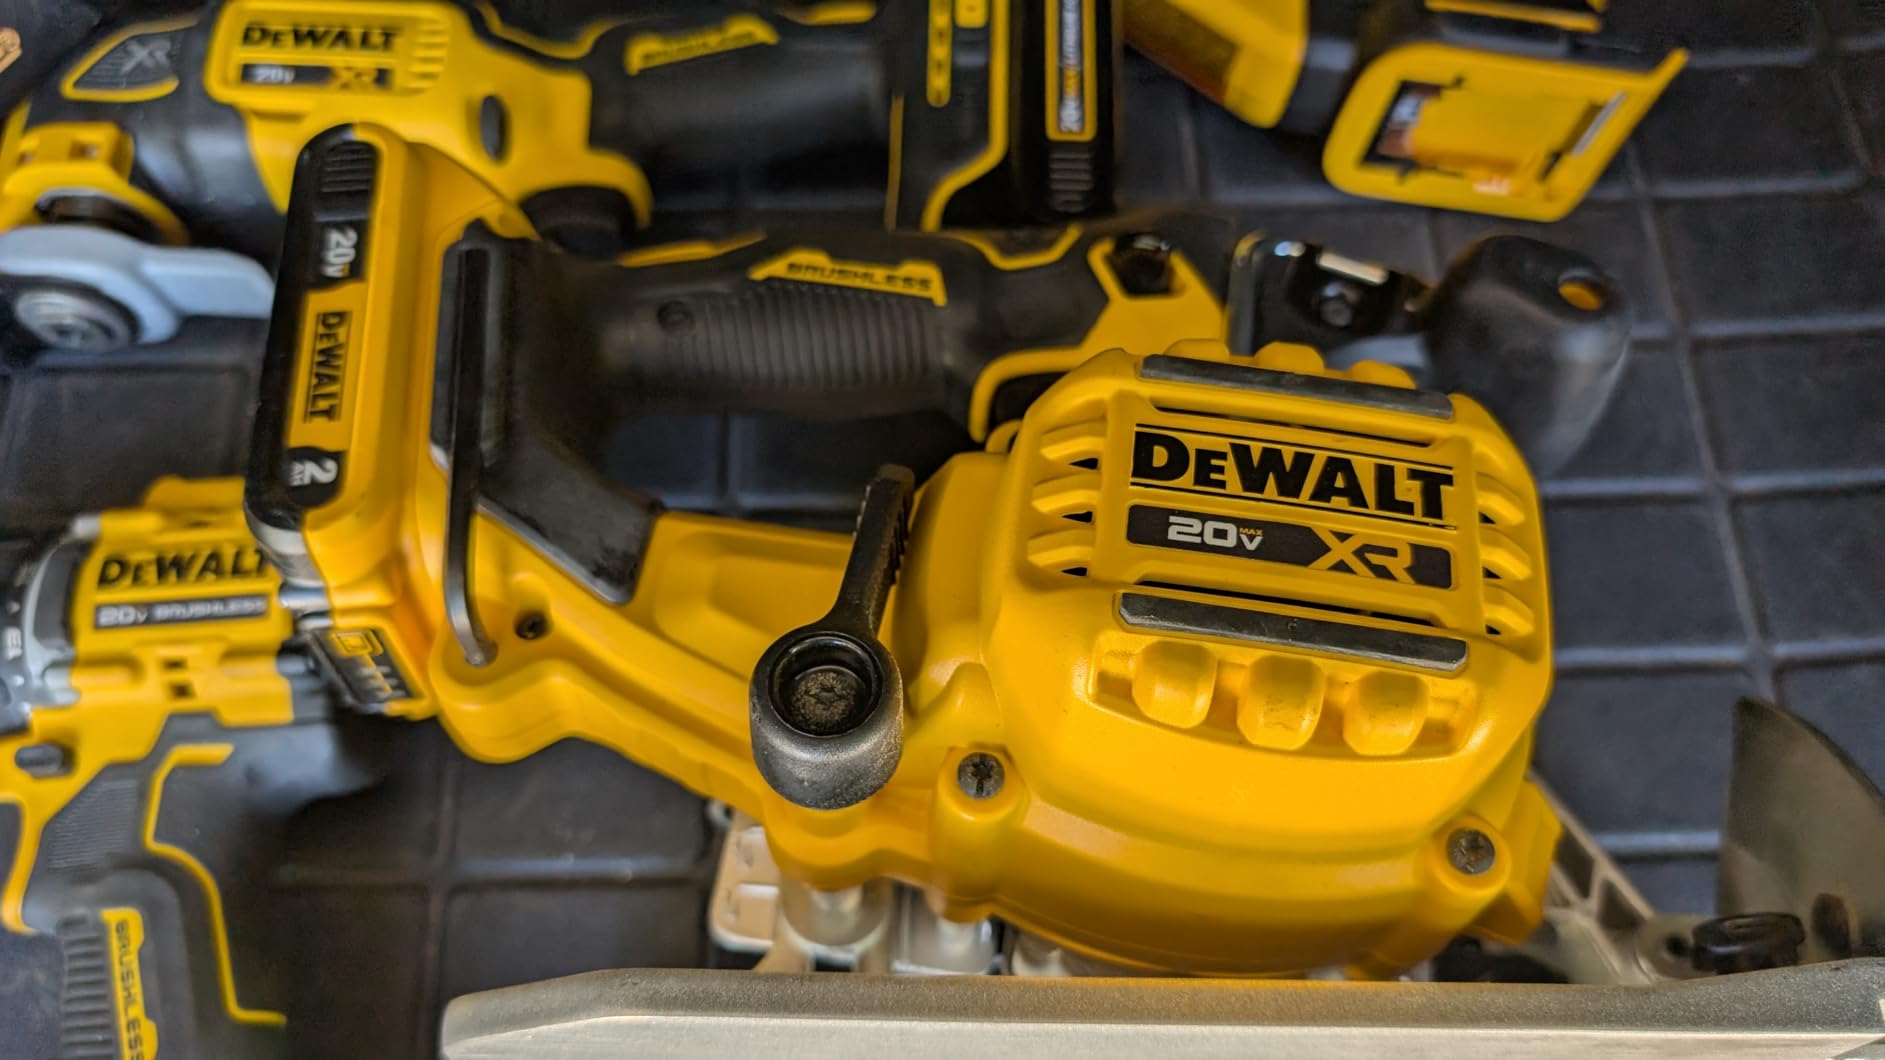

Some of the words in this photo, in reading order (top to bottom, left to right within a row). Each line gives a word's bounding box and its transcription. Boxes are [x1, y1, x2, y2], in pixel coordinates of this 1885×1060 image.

[786, 262, 933, 291] BRUSHLESS
[309, 311, 348, 422] DEWALT
[1131, 431, 1455, 521] DEWALT
[1239, 527, 1264, 536] MAX
[1308, 528, 1415, 585] XR
